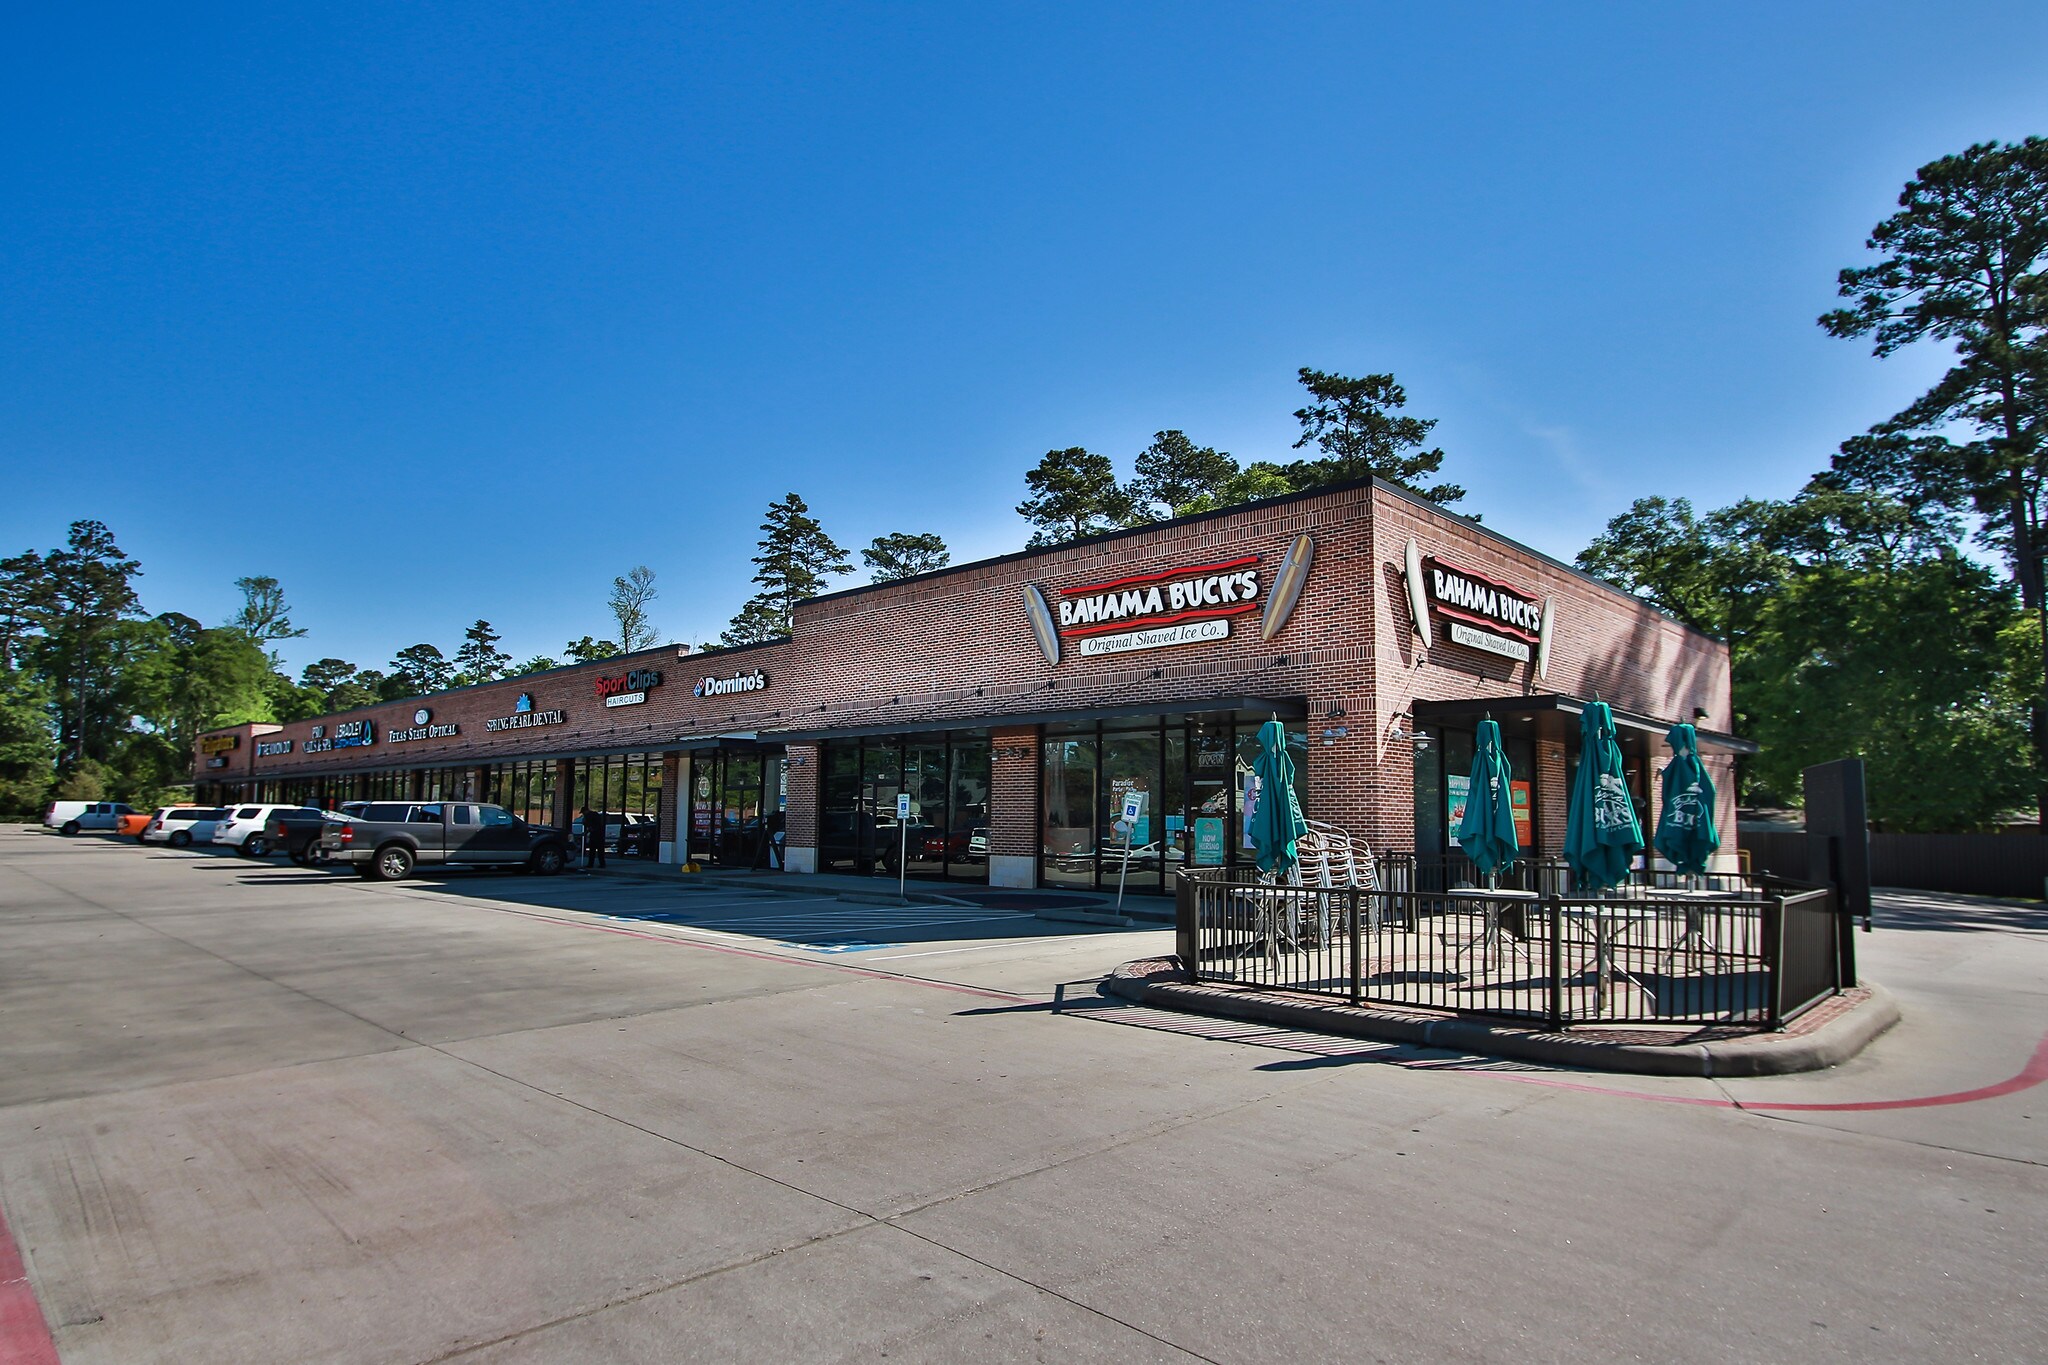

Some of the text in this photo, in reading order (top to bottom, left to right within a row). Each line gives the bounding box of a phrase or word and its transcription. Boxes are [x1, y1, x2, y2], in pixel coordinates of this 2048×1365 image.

[1059, 571, 1258, 626] BAHAMA BUCK'S
[1433, 569, 1540, 631] BAHAMA BUCK'S
[1088, 634, 1133, 653] Original
[1136, 629, 1177, 646] Shaved
[1179, 626, 1198, 640] Ice
[1456, 625, 1484, 645] Original
[1484, 633, 1506, 653] Shaved
[1507, 640, 1516, 655] Ice
[704, 669, 765, 696] Domino's
[607, 694, 644, 706] HAIRCUTS
[486, 710, 563, 732] SPRING PEARL DENTAL
[1198, 754, 1225, 765] OPEN
[1199, 842, 1220, 851] HIRING
